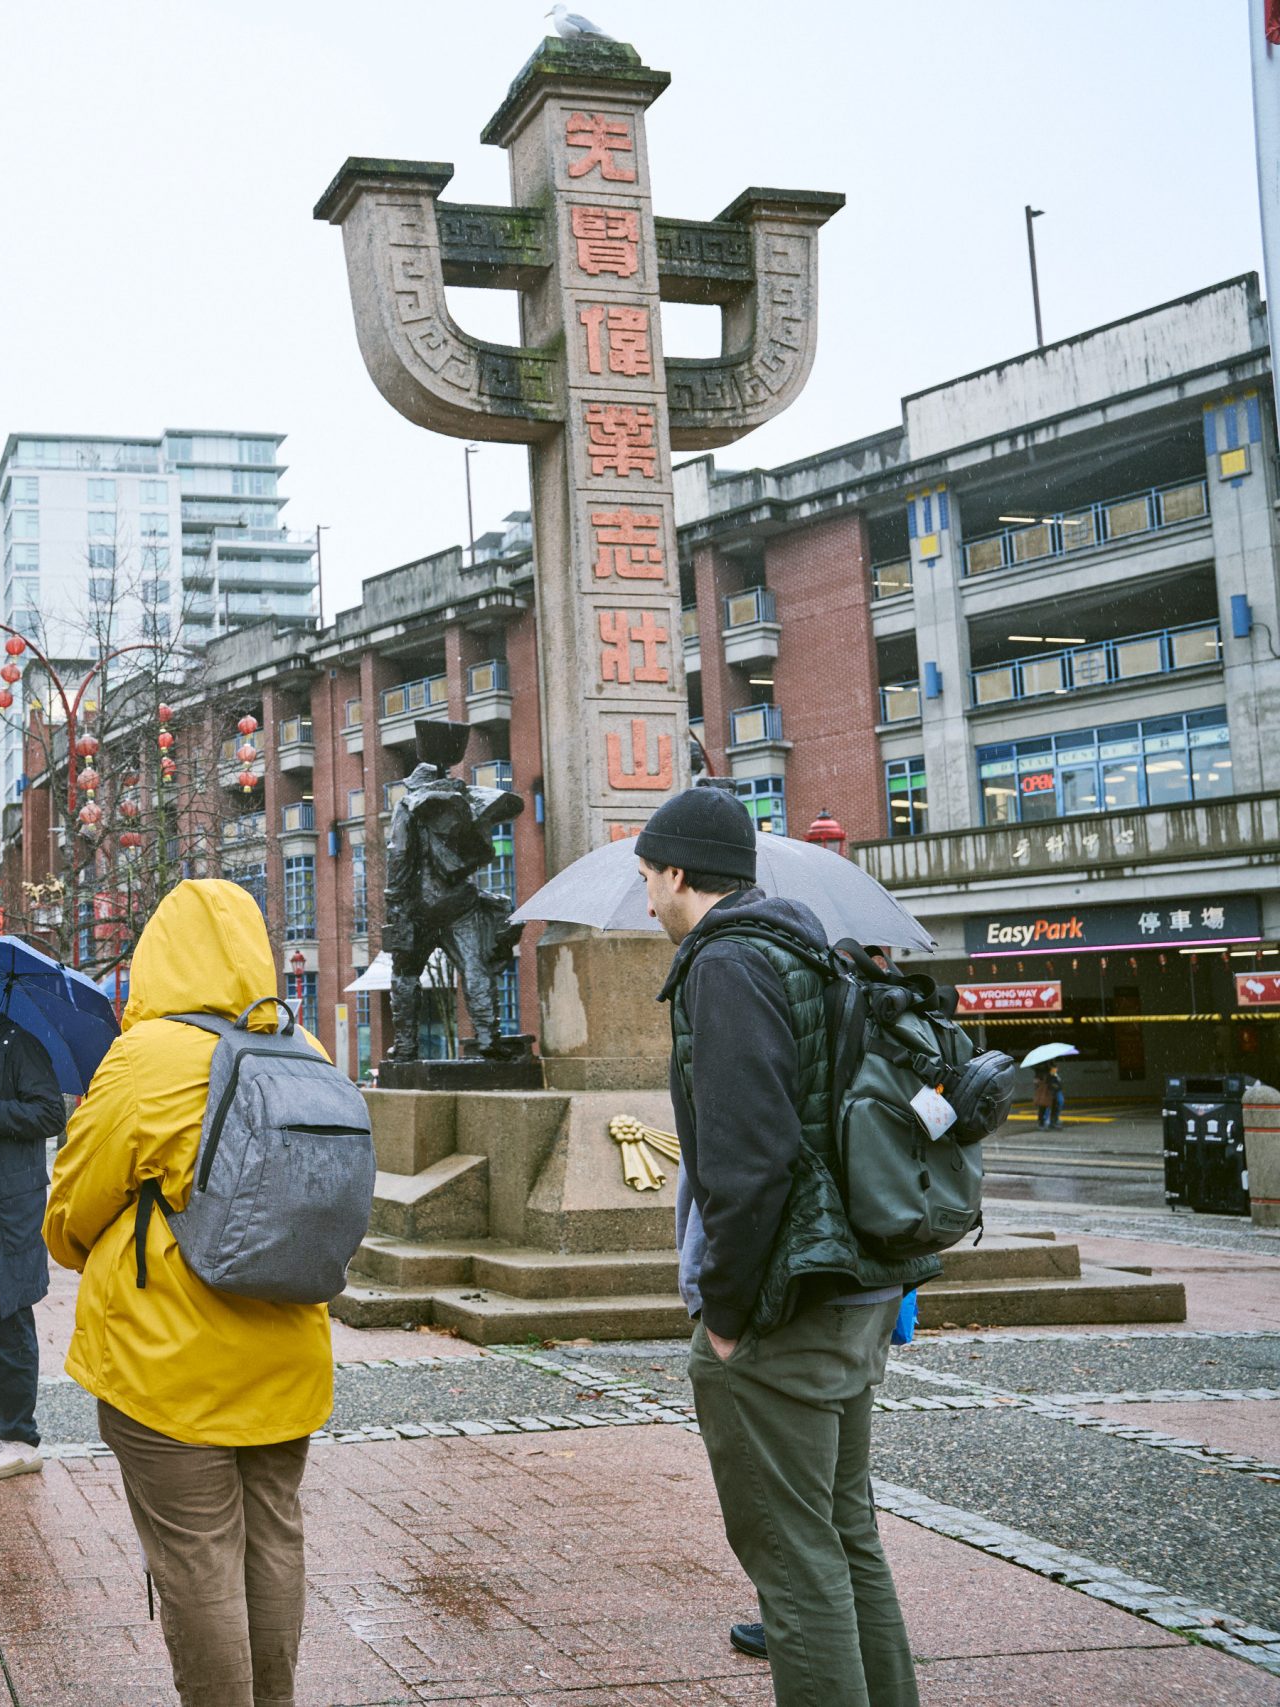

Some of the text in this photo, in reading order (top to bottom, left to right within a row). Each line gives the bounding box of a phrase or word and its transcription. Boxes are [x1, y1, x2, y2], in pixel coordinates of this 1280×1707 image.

[565, 112, 673, 842] 先賢偉業志壯山
[1022, 773, 1054, 793] OPEN
[987, 916, 1083, 947] EasyPark
[979, 988, 1038, 999] WRONG WAY
